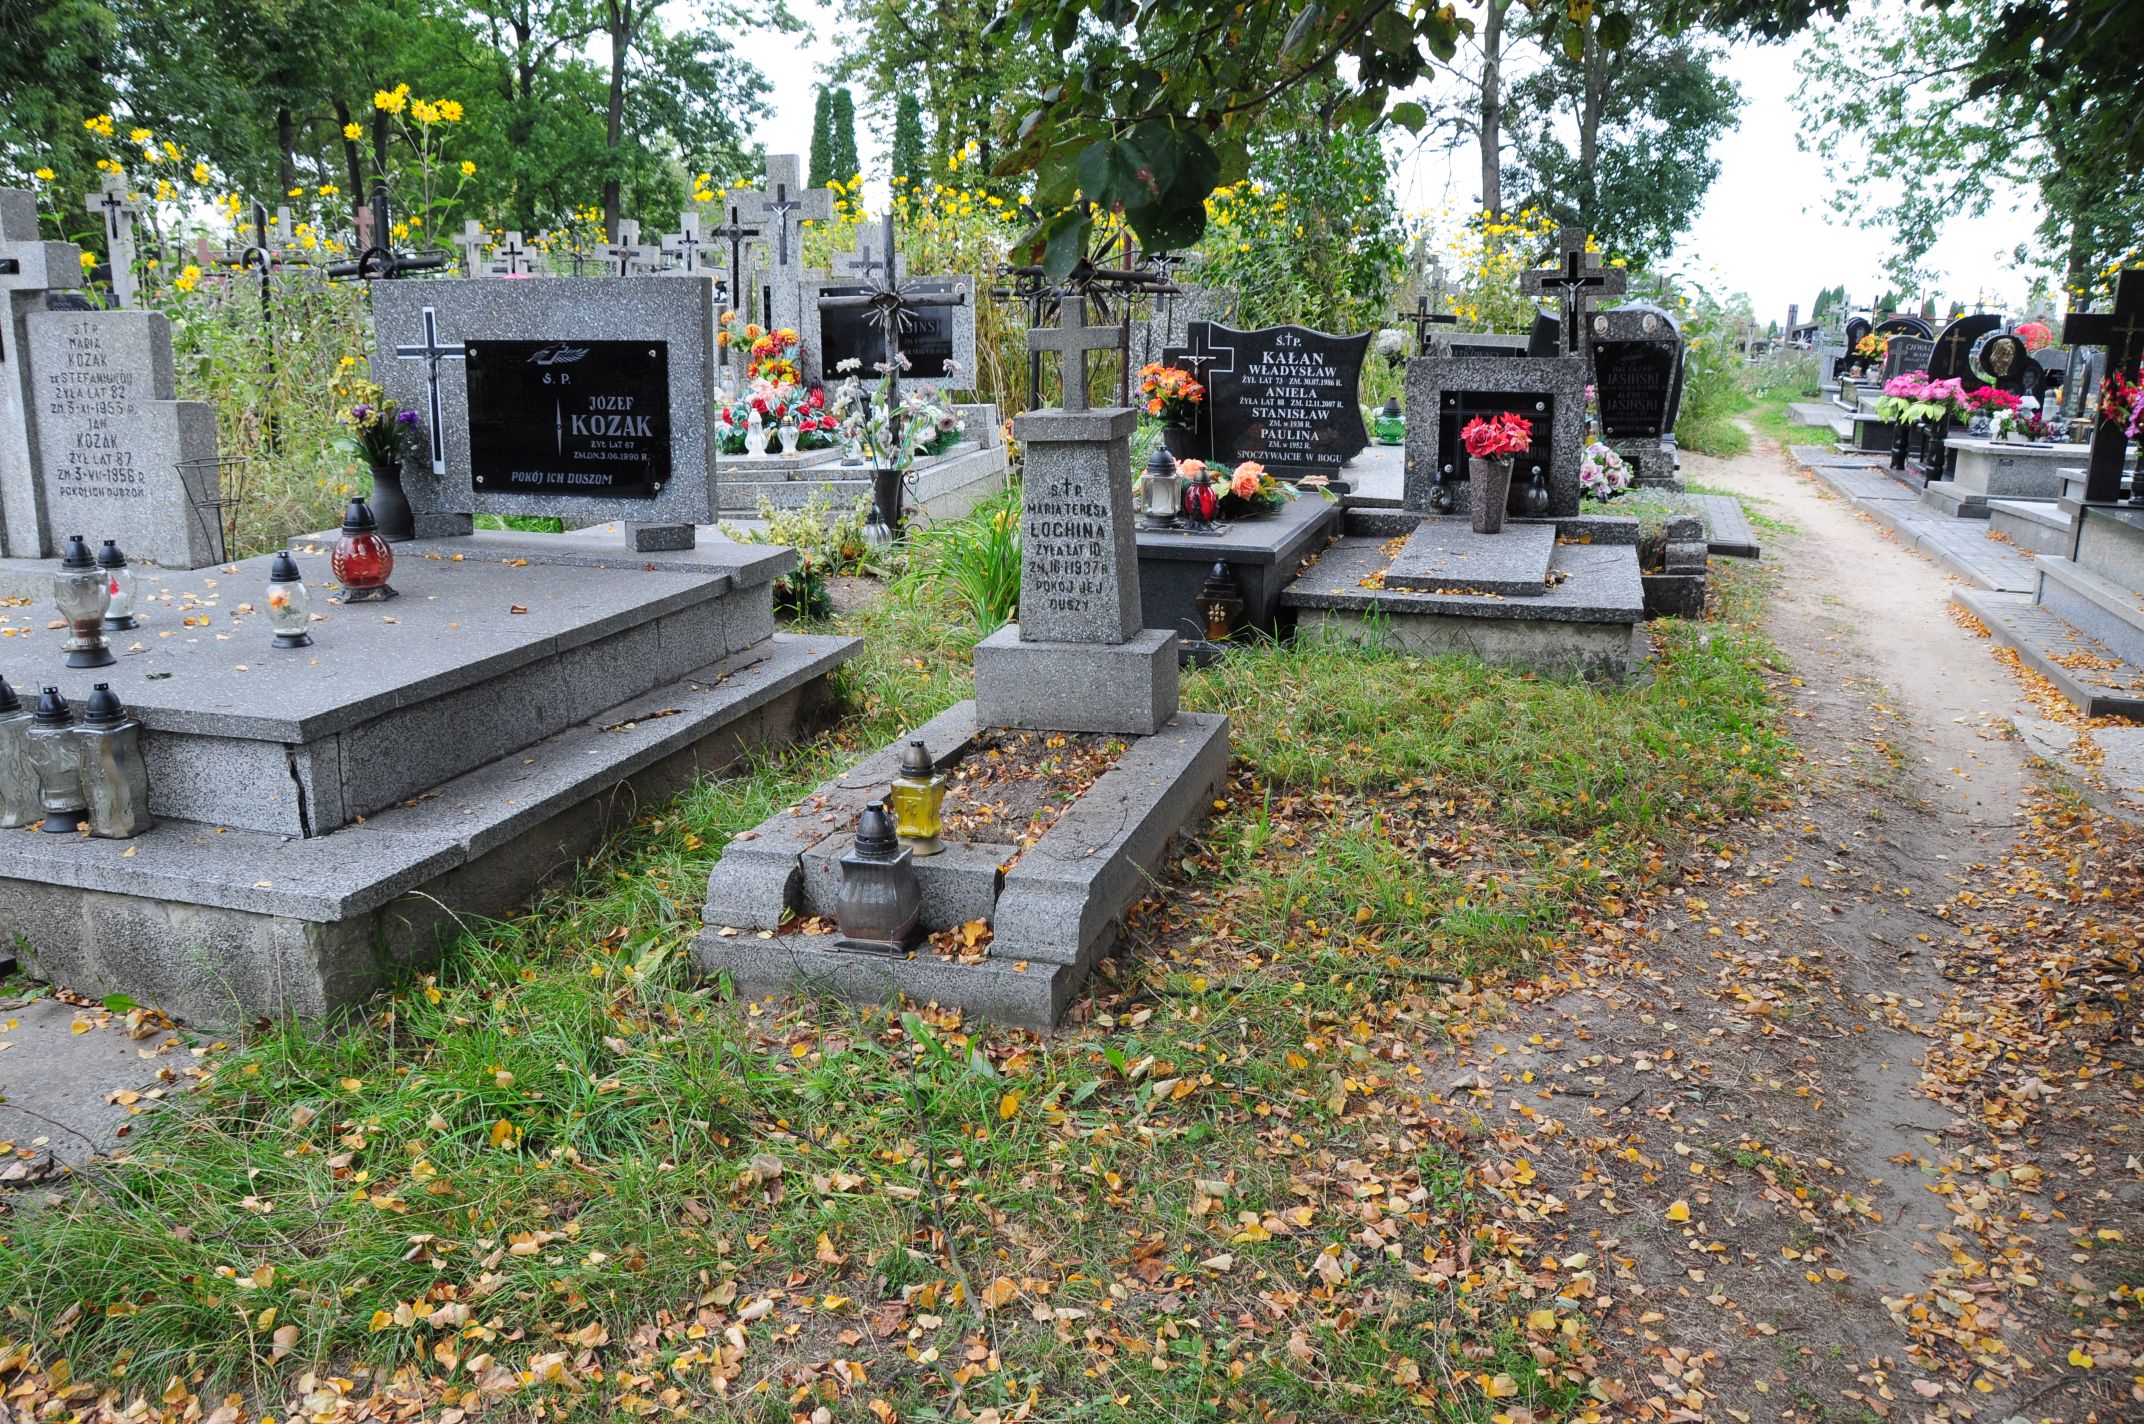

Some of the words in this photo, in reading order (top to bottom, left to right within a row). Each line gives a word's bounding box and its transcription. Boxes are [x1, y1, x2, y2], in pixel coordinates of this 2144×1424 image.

[68, 352, 107, 367] KOZAK
[1262, 351, 1324, 365] KAŁAN
[1249, 364, 1337, 377] WŁADYSŁAW
[1242, 374, 1256, 384] ŻYŁ
[1259, 376, 1273, 384] LAT
[1275, 377, 1283, 385] 73
[1289, 377, 1302, 385] ZM.
[1336, 379, 1343, 387] R.
[111, 385, 126, 399] 82
[1266, 386, 1317, 398] ANIELA
[589, 394, 634, 411] JÓZEF
[1240, 396, 1258, 405] ŻYŁA
[1261, 398, 1274, 406] LAT
[1290, 399, 1304, 407] ZM.
[1337, 401, 1344, 409] R.
[1252, 407, 1330, 420] STANISŁAW
[88, 418, 107, 430] JAN
[571, 414, 653, 437] KOZAK
[77, 433, 118, 449] KOZAK
[1260, 428, 1319, 441] PAULINA
[93, 453, 112, 465] LAT
[117, 451, 132, 466] 87
[1237, 450, 1301, 461] SPOCZYWAJCIE
[1317, 454, 1343, 463] BOGU
[511, 470, 543, 485] POKÓJ
[546, 472, 564, 483] ICH
[567, 473, 613, 485] DUSZOM
[1027, 503, 1062, 517] MARIA
[1030, 521, 1105, 539] ŁOCHINA
[1066, 543, 1084, 556] LAT
[1050, 598, 1090, 612] DUSZY
